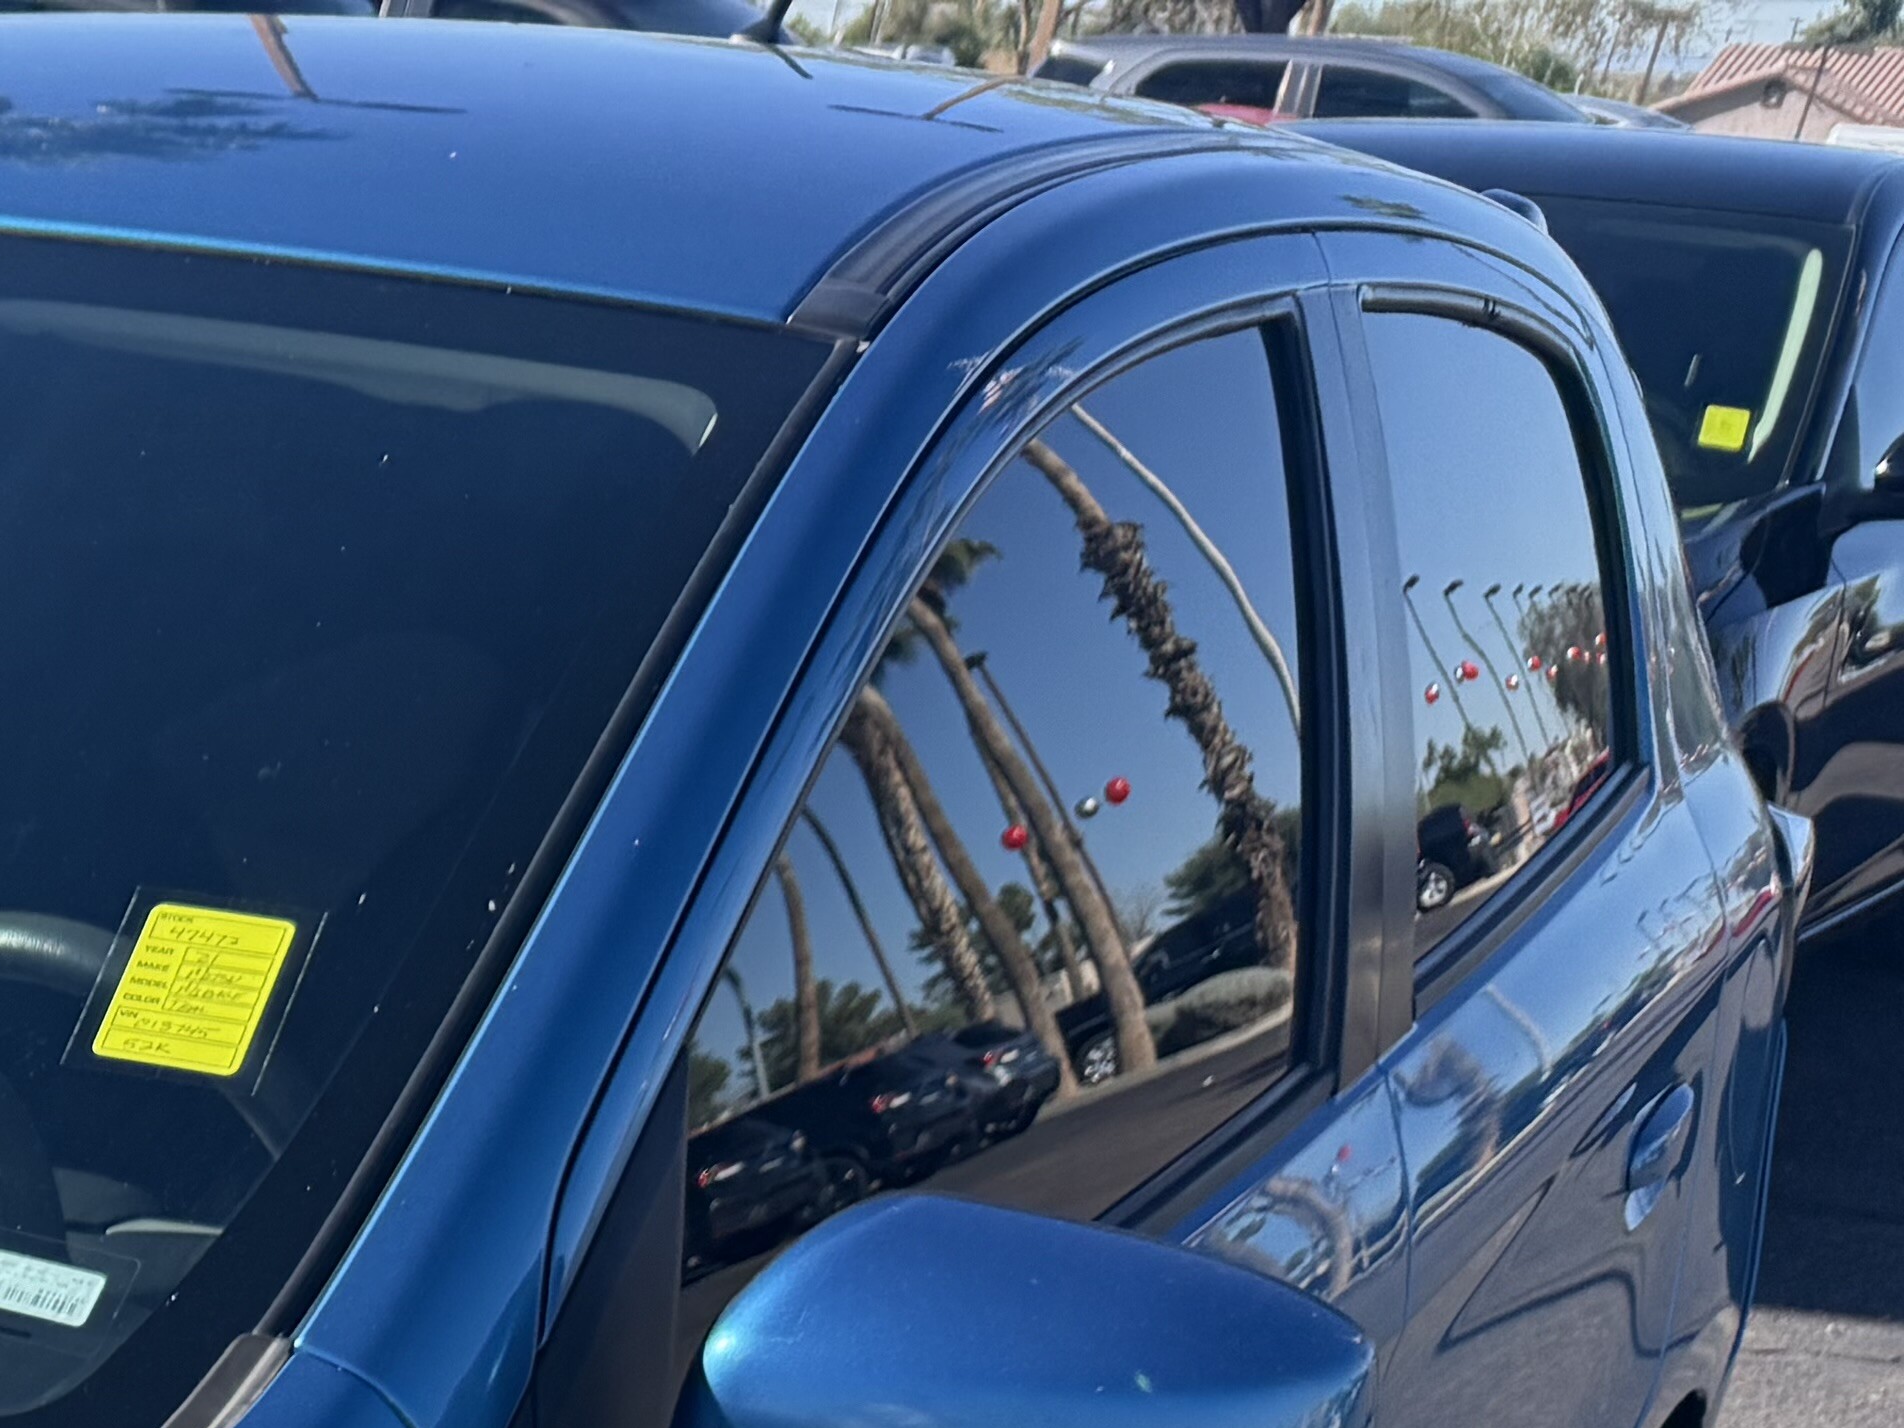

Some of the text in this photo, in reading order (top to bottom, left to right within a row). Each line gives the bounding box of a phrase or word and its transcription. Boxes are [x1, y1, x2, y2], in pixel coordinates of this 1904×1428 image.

[160, 912, 193, 924] STOCK
[145, 945, 175, 956] YEAR
[136, 960, 170, 972] MAKE
[129, 976, 168, 989] MODEL
[123, 992, 161, 1005] COLOR
[119, 1009, 138, 1019] VIN
